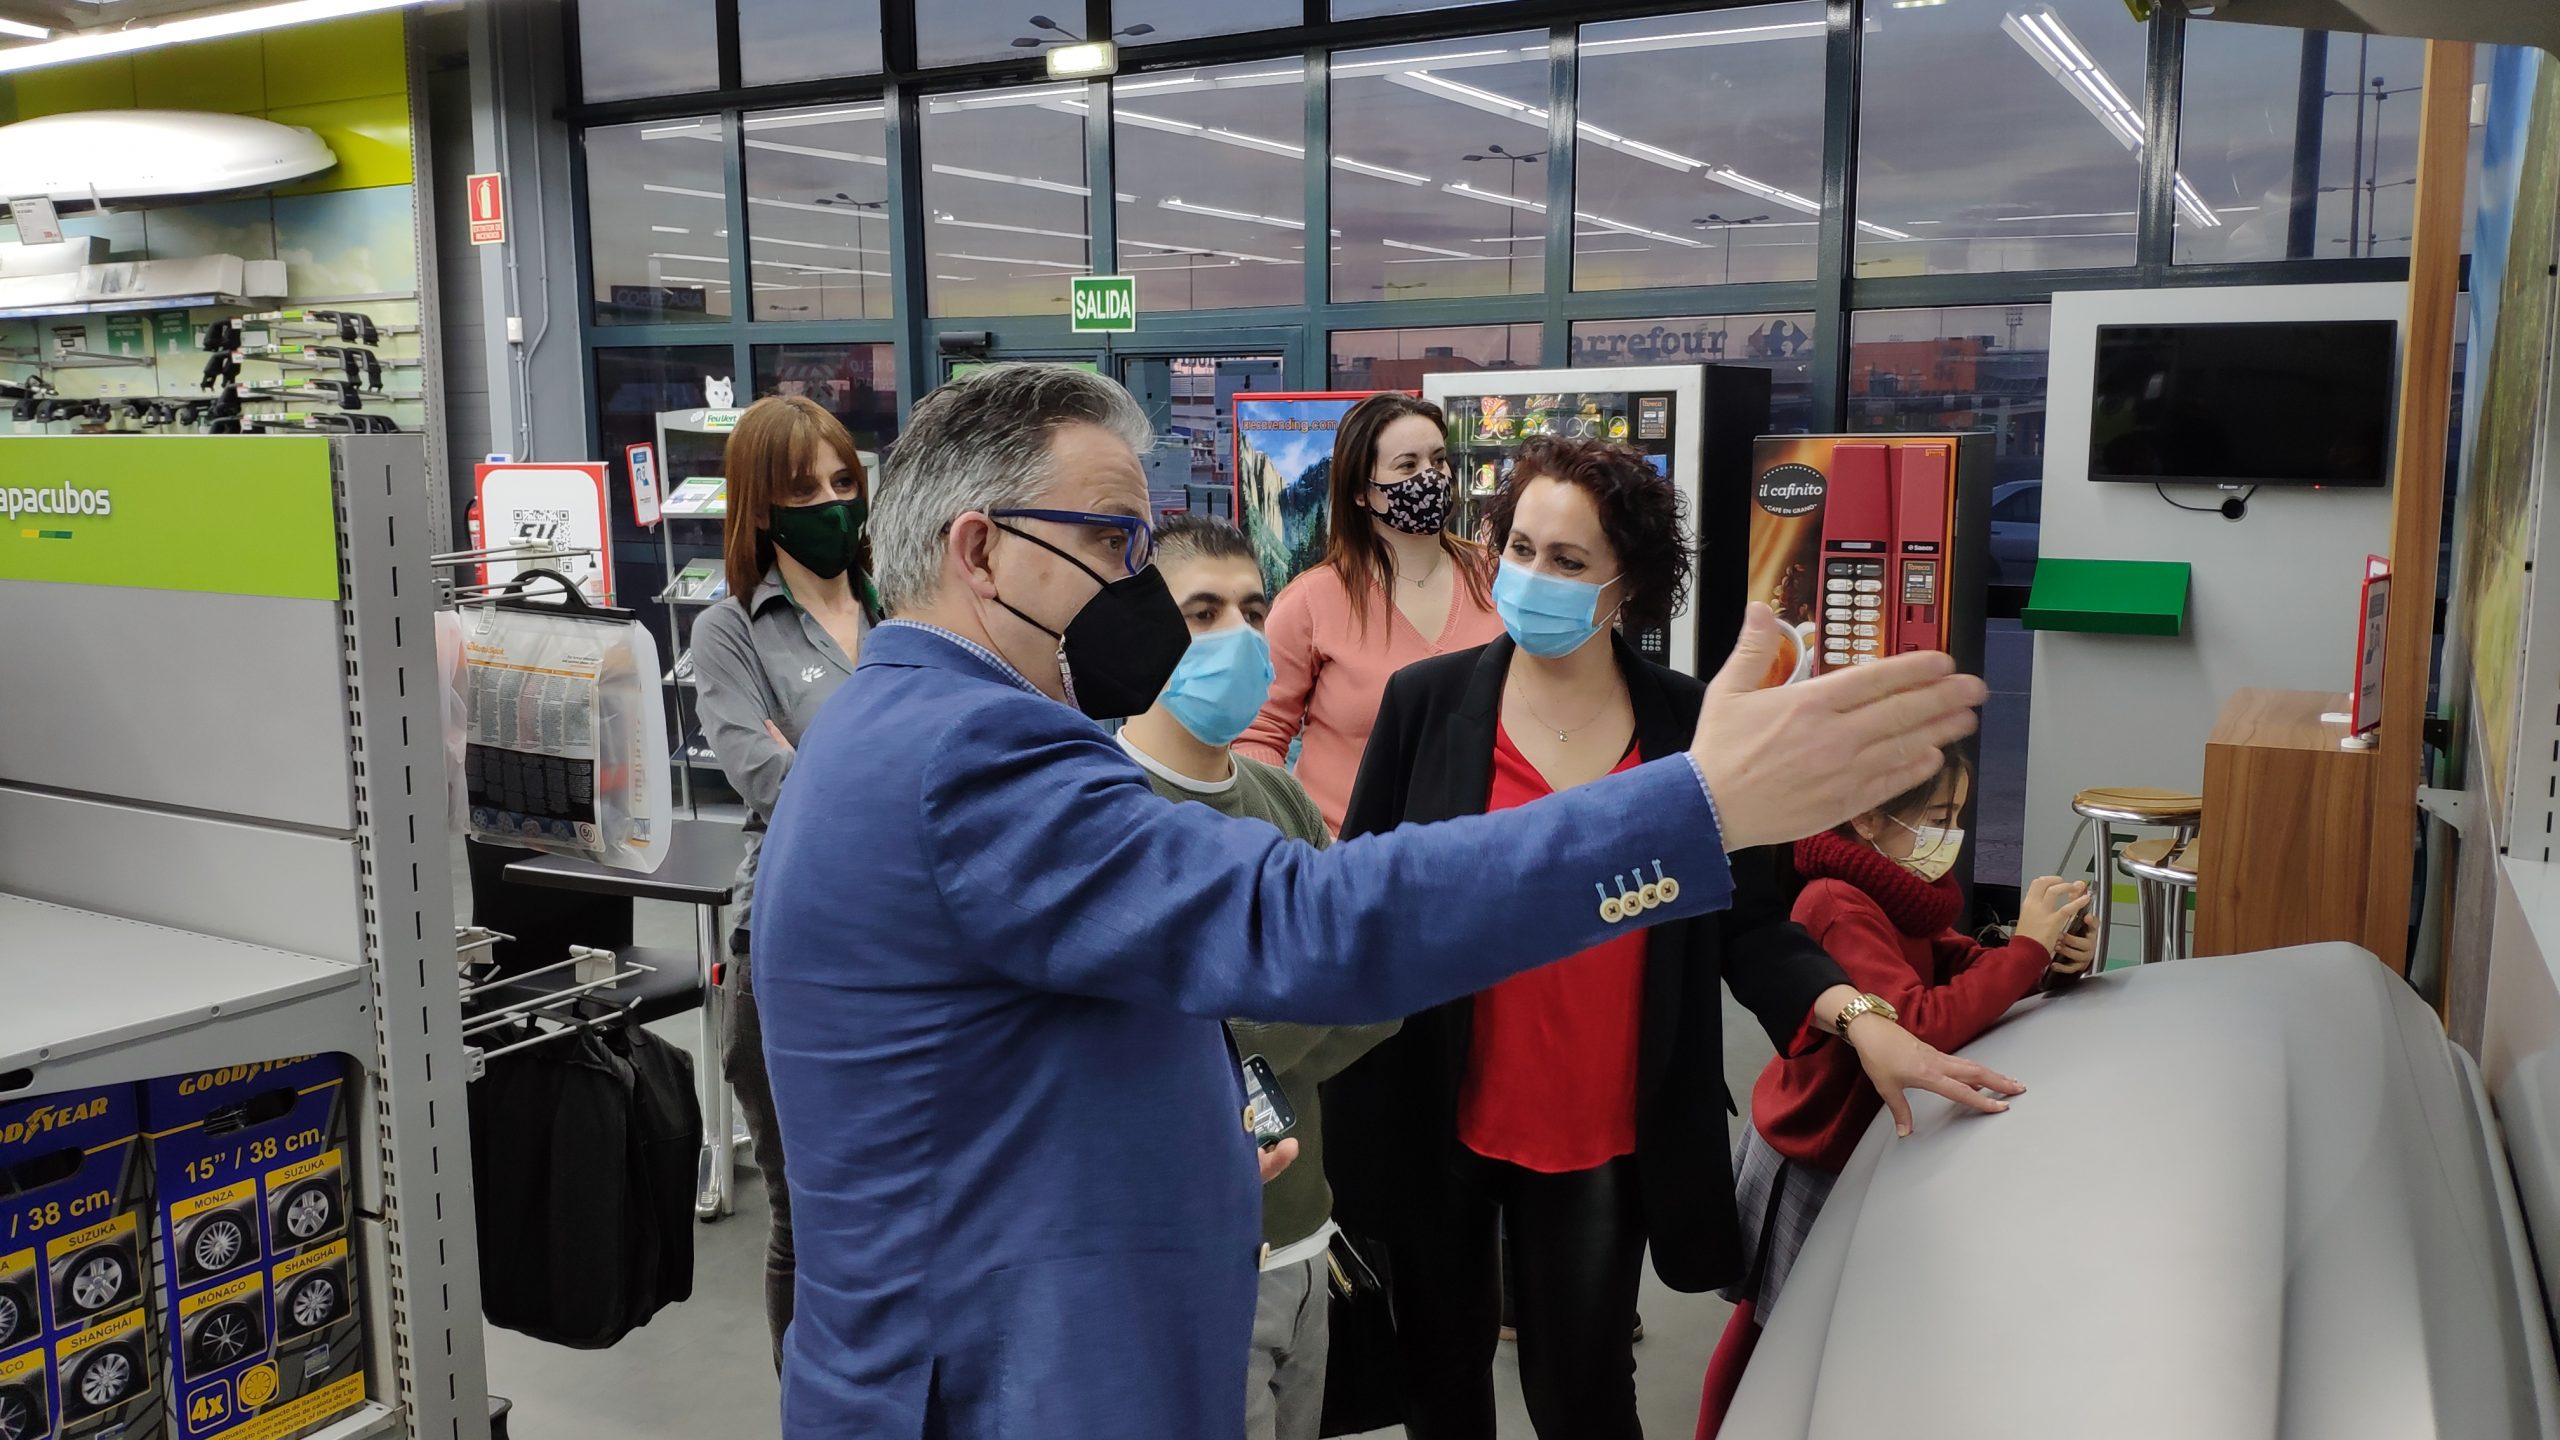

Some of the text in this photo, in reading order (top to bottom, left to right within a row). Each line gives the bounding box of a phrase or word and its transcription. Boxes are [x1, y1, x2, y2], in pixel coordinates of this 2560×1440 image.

[1076, 289, 1132, 320] SALIDA
[0, 480, 111, 520] apacubos
[1759, 482, 1823, 500] il cafinito
[234, 1146, 242, 1170] /
[250, 1137, 278, 1164] 38
[285, 1127, 326, 1152] cm.
[284, 1158, 326, 1180] SUZUKA
[194, 1189, 235, 1209] MONZA
[10, 1190, 117, 1238] / 38 cm.
[68, 1223, 118, 1248] SUZUKA
[285, 1246, 337, 1273] SHANGHAI
[197, 1281, 247, 1306] MONACO
[71, 1317, 132, 1349] SHANGHAI
[191, 1394, 225, 1422] 4x
